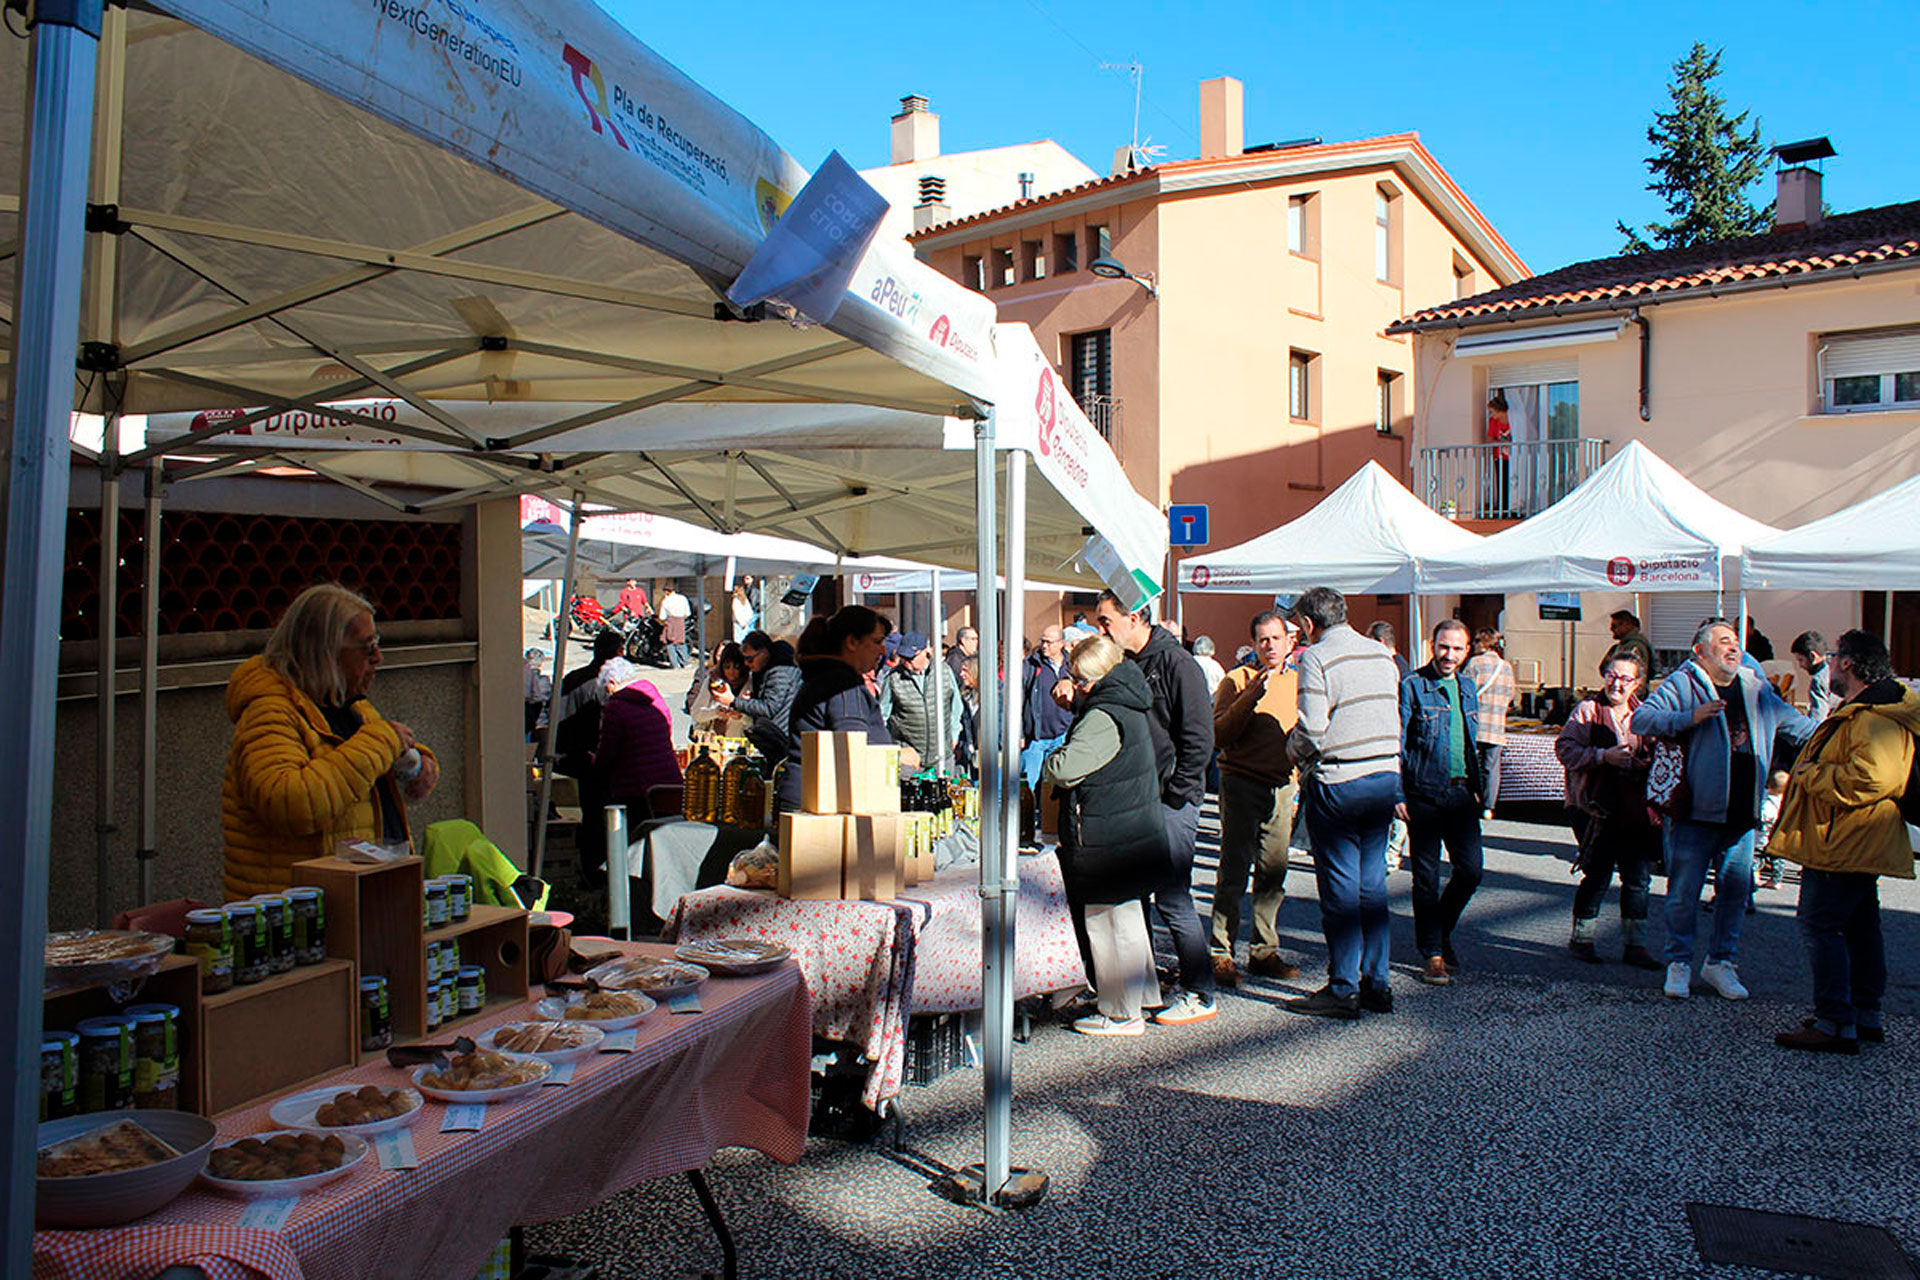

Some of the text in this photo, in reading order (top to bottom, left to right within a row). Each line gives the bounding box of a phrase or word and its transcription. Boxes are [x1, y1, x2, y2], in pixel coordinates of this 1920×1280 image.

[614, 84, 634, 116] Pla
[637, 104, 654, 129] de
[657, 115, 730, 186] Recuperació,
[1640, 572, 1699, 582] Barcelona
